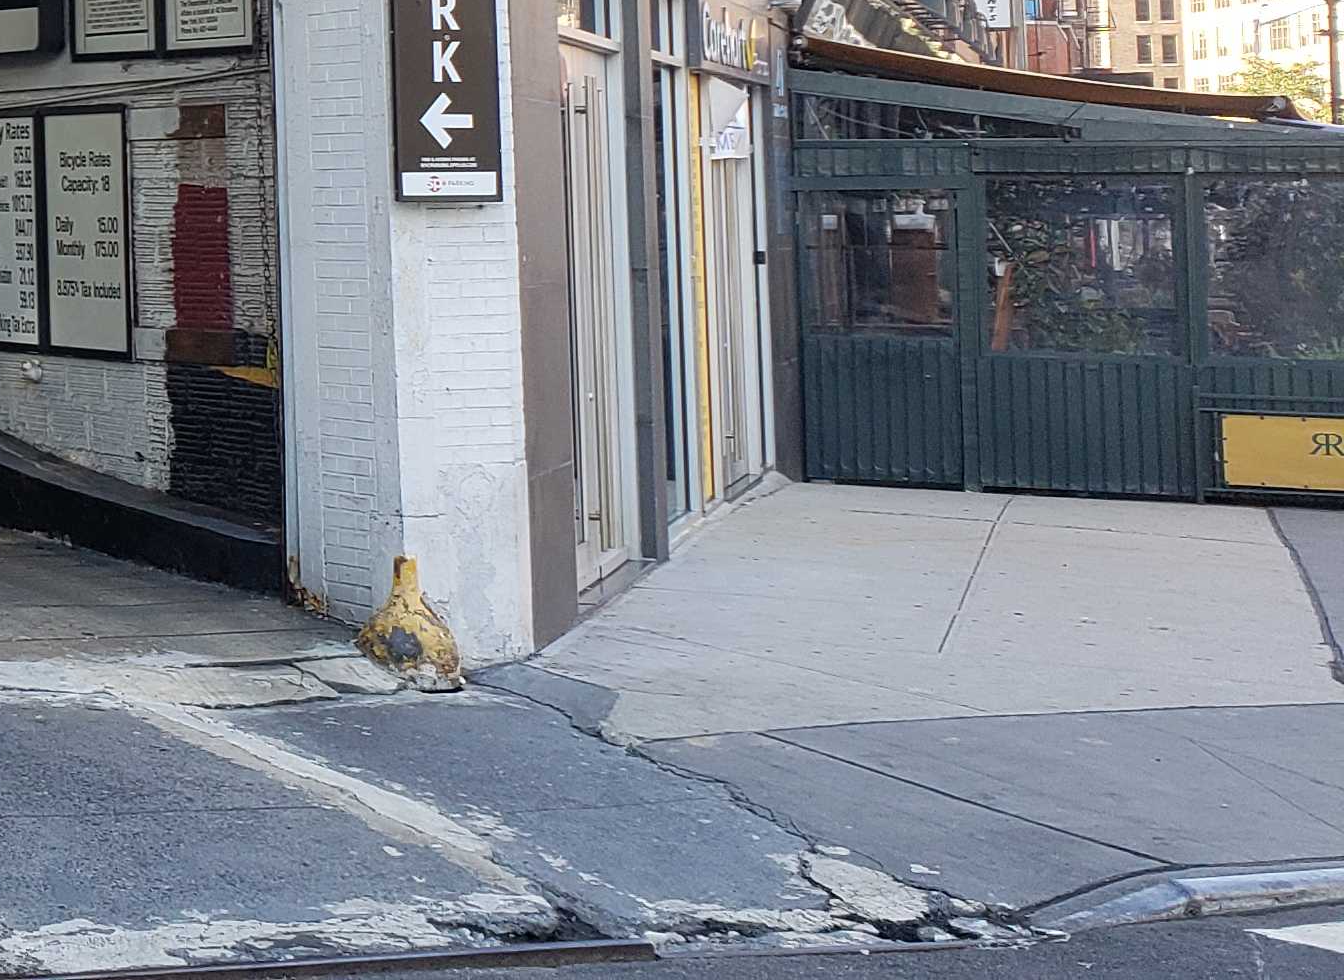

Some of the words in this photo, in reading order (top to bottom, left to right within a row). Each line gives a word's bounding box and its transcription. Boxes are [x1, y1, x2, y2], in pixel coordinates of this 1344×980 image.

[5, 122, 30, 140] Rates
[59, 151, 86, 170] Bicycle
[89, 151, 111, 168] Rates
[62, 175, 99, 195] Capacity:
[101, 175, 110, 192] 18
[55, 216, 73, 236] Daily
[97, 217, 118, 233] 15.00
[56, 240, 86, 260] Monthly
[94, 241, 119, 258] 175.00
[80, 281, 92, 298] Tax
[93, 282, 121, 300] Included
